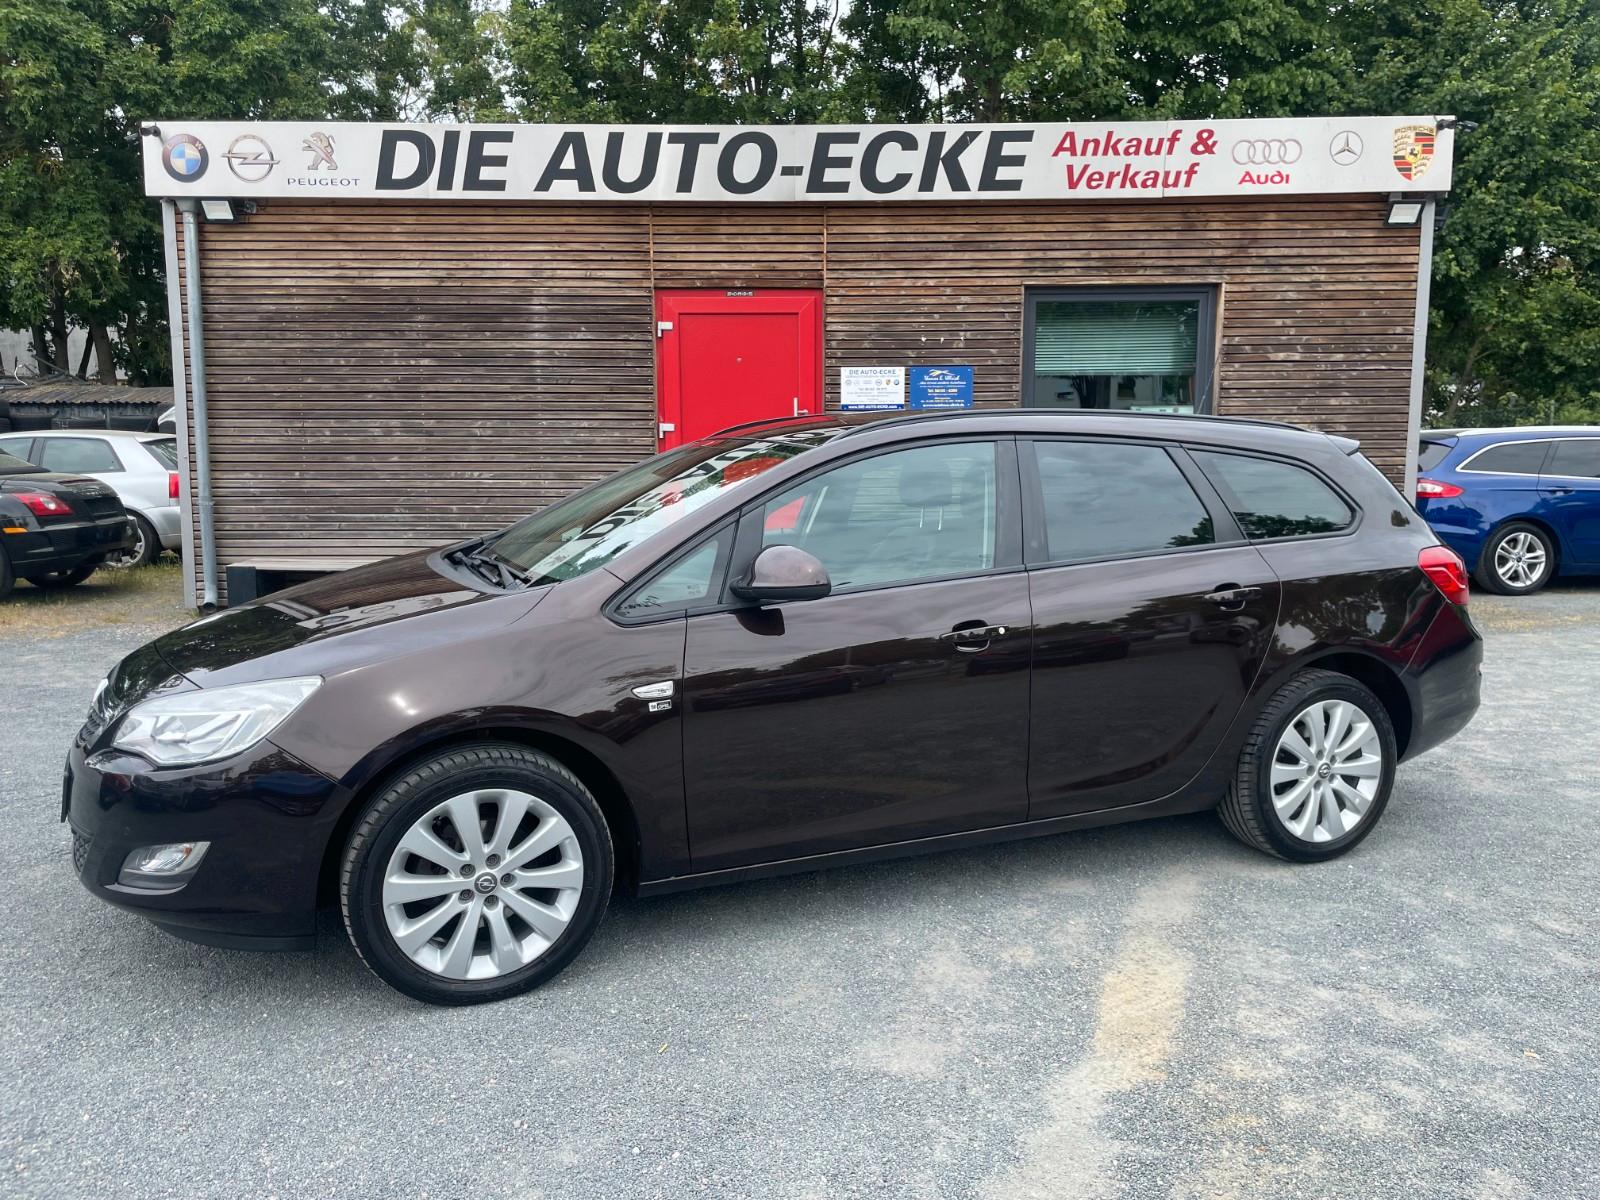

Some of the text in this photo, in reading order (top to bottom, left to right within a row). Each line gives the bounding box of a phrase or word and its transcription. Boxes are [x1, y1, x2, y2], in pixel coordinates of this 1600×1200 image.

[1052, 128, 1218, 157] Ankauf &
[375, 129, 1035, 195] DIE AUTO-ECKE
[1065, 162, 1200, 190] Verkauf
[287, 177, 361, 187] PEUGEOT
[1238, 170, 1290, 185] Audi
